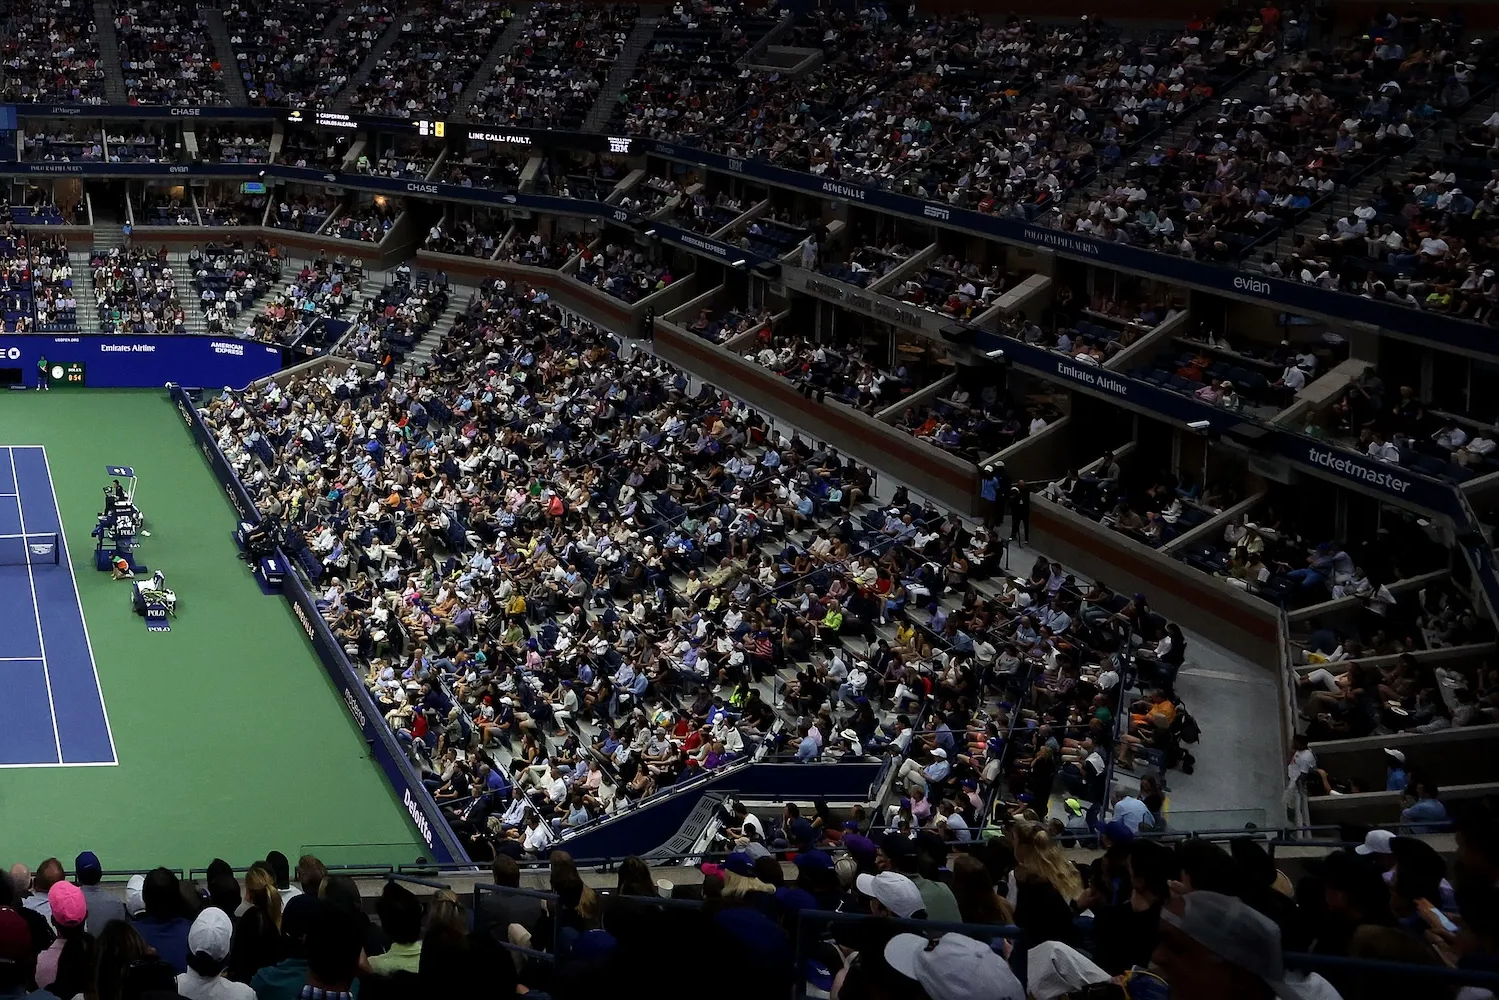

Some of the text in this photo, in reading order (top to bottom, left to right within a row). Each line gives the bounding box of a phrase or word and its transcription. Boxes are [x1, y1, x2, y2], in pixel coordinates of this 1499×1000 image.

[170, 108, 200, 116] CHASE
[468, 132, 532, 144] LINE CALL: FAULT.
[610, 144, 628, 153] IBM
[407, 183, 439, 193] CHASE
[822, 181, 865, 200] ASHEVILLE
[923, 205, 950, 220] ESPN
[1233, 276, 1271, 295] evian
[100, 344, 156, 352] Emirates Airline
[210, 342, 244, 351] AMERICAN
[215, 347, 244, 356] EXPRESS
[1057, 362, 1128, 395] Emirates Airline
[1308, 447, 1411, 493] ticketmaster
[147, 609, 166, 617] POLO
[403, 787, 433, 850] Deloitte.
